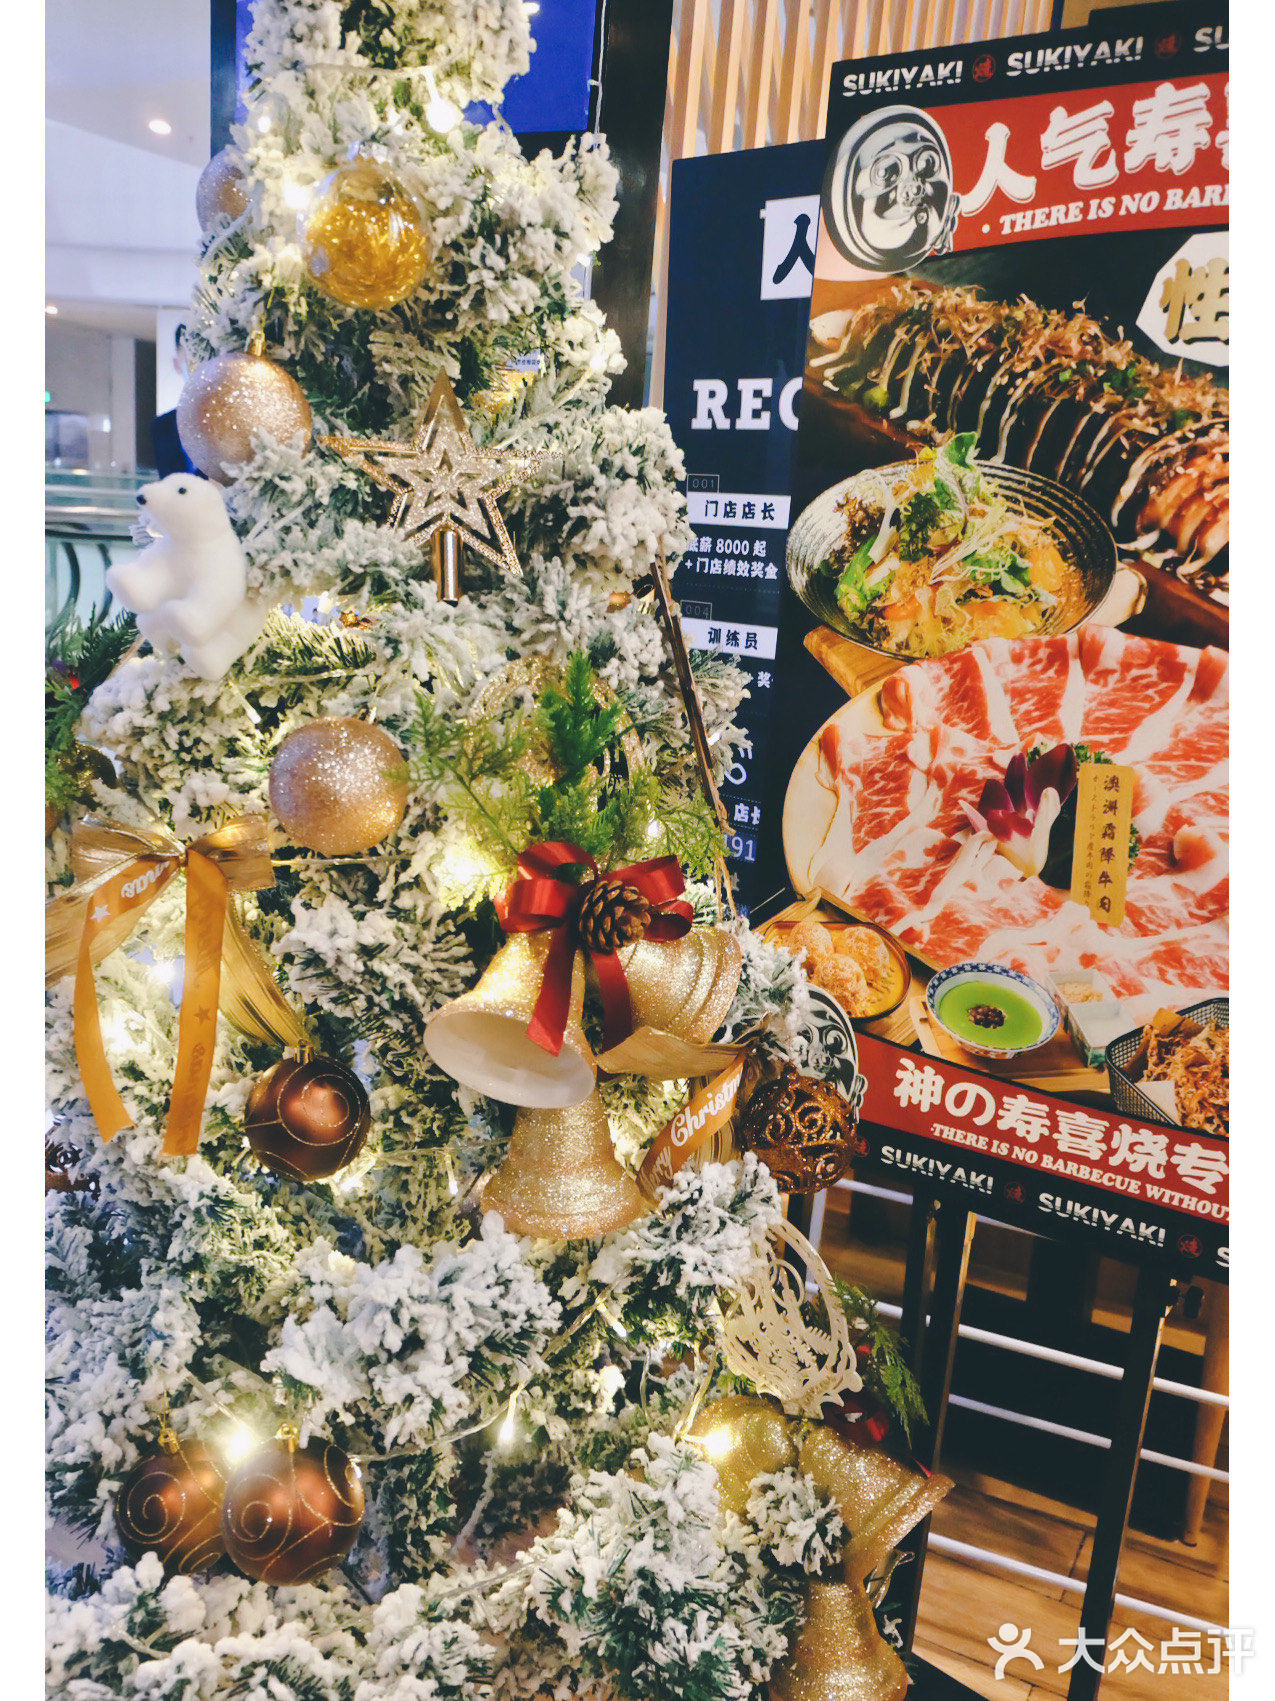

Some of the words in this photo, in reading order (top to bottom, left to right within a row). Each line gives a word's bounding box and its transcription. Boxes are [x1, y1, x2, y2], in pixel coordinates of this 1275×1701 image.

[960, 82, 1229, 216] 人气寿
[1000, 201, 1084, 235] THERE
[1087, 197, 1116, 220] IS
[1119, 191, 1160, 216] NO
[690, 376, 803, 431] REC
[704, 500, 775, 521] 门店店长
[716, 538, 750, 555] 8000
[753, 539, 767, 557] 起
[708, 627, 758, 650] 训练员
[893, 1057, 1229, 1195] 神の寿喜烧专
[932, 1123, 989, 1150] THERE
[991, 1140, 1010, 1156] IS
[1011, 1145, 1038, 1163] NO
[1040, 1154, 1141, 1194] BARBECUE
